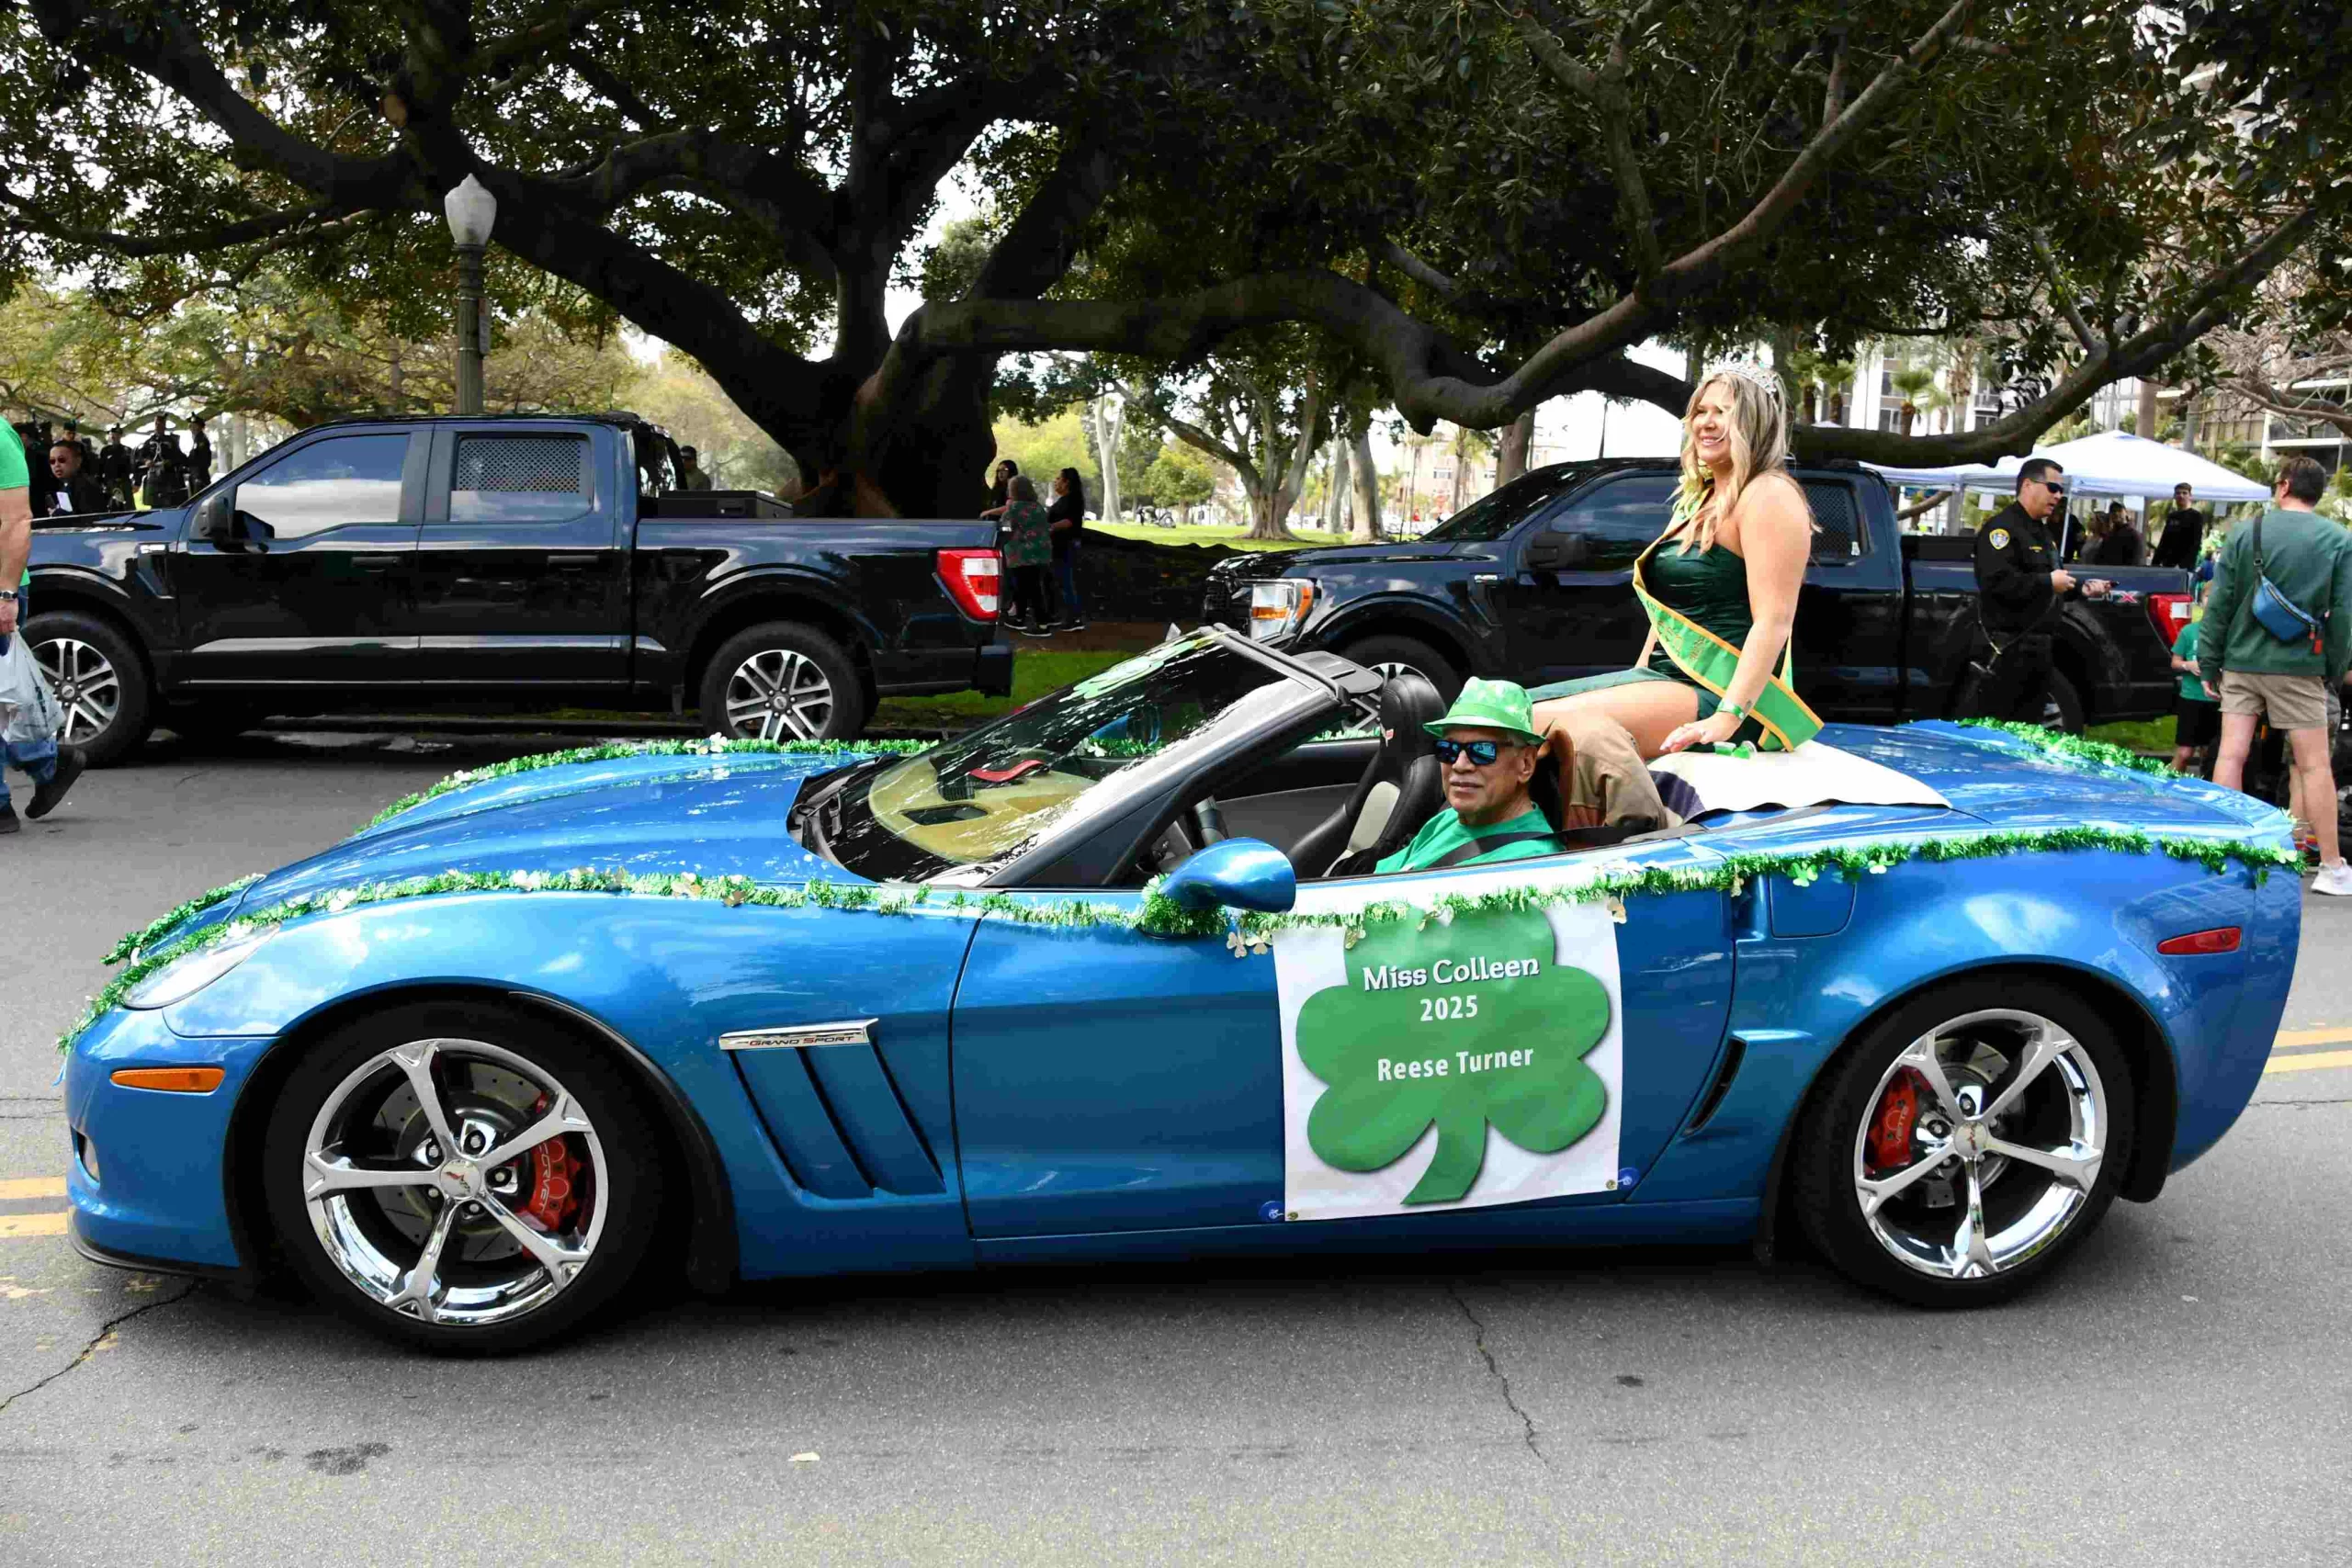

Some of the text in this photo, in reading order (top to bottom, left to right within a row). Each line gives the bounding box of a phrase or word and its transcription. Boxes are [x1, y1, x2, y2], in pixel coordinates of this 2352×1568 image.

[1363, 956, 1540, 992] Miss Colleen
[1419, 995, 1478, 1021] 2025
[749, 1035, 854, 1046] GRAND SPORT
[1377, 1047, 1533, 1081] Reese Turner
